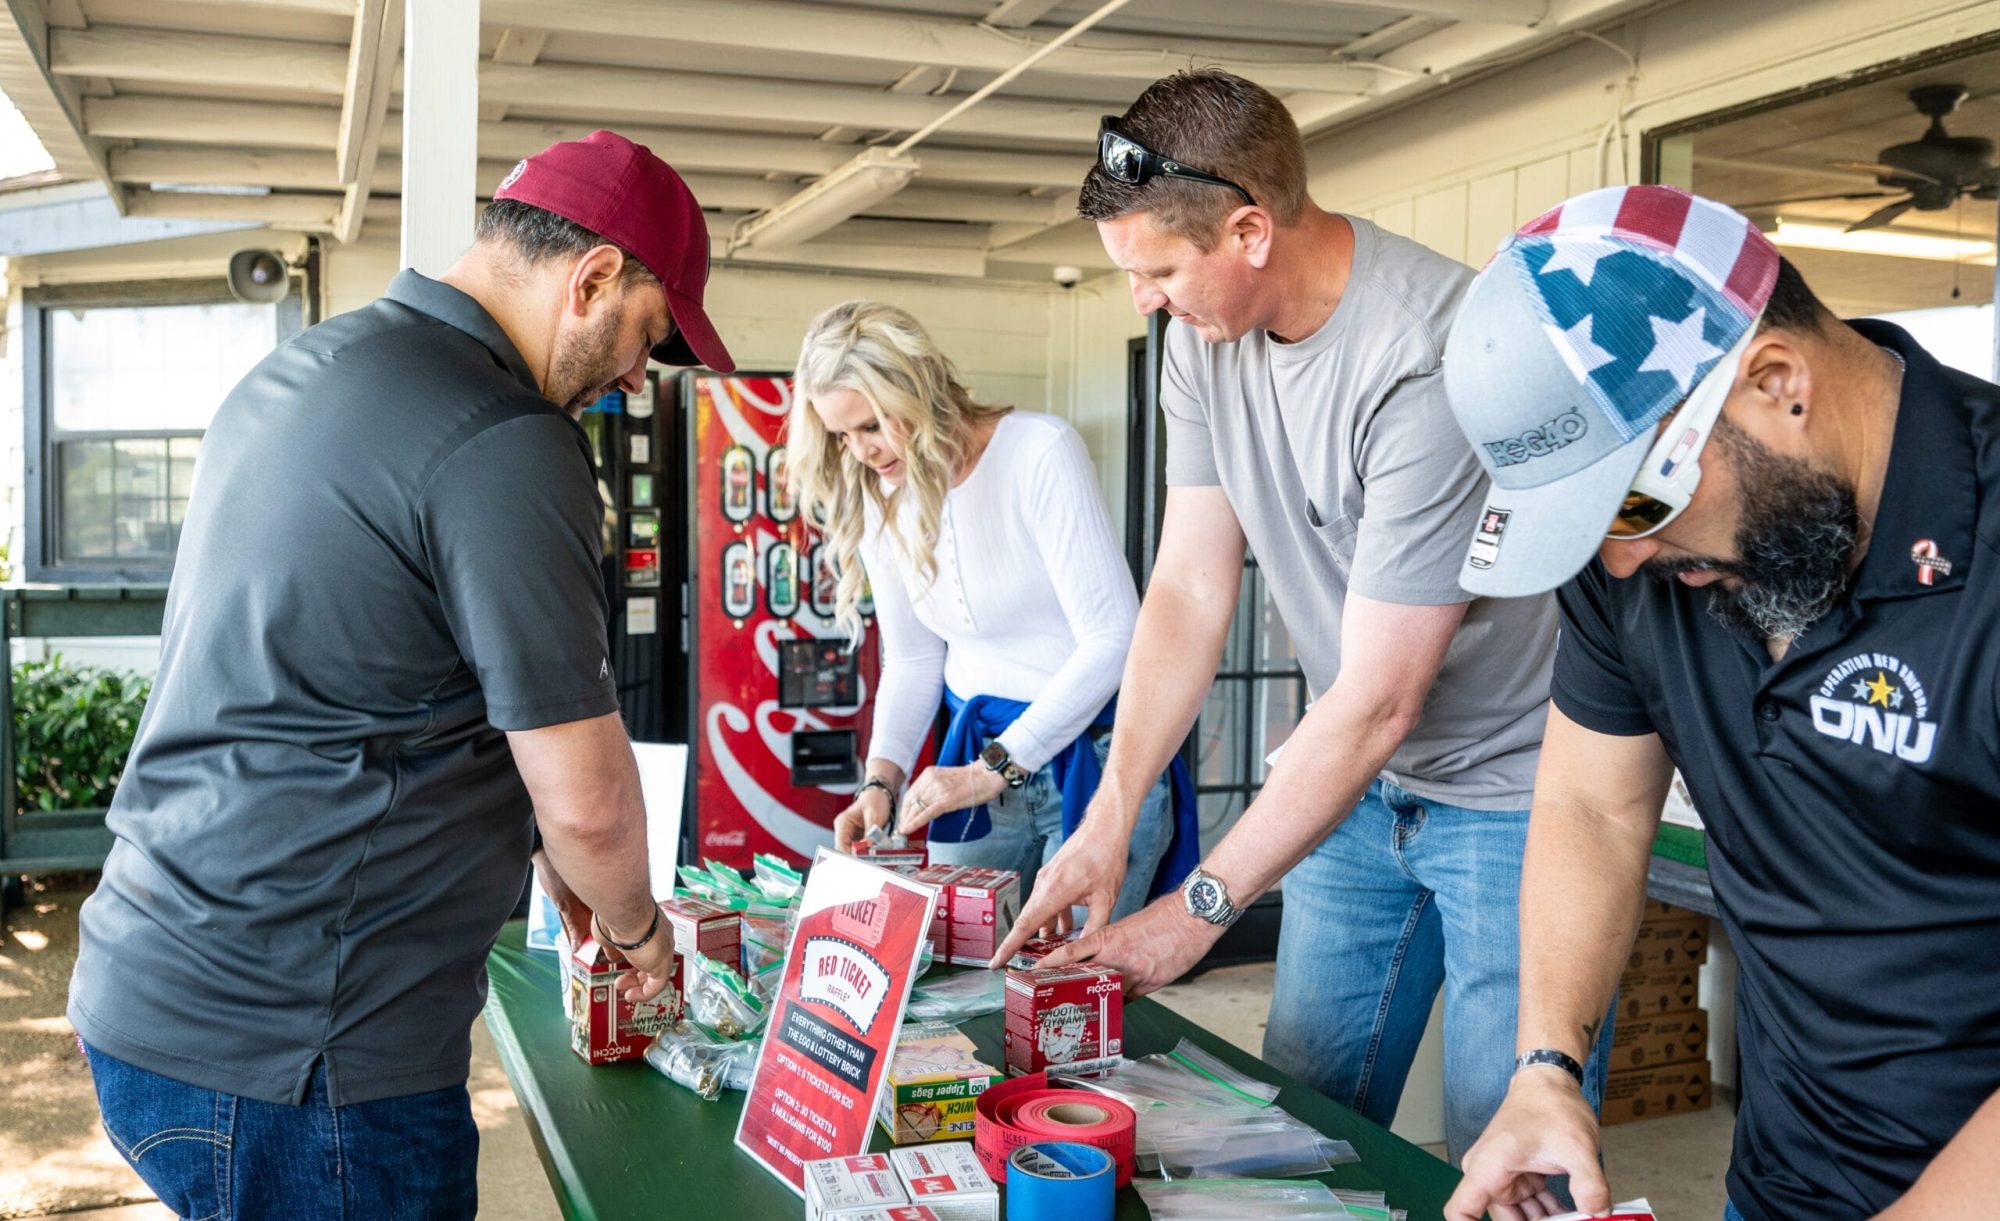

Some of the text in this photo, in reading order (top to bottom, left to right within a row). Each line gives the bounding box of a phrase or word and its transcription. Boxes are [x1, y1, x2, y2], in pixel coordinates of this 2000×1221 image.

[1820, 653, 1872, 697] OPERATION
[1872, 653, 1899, 673] NEW
[1810, 694, 1937, 763] ONU
[818, 955, 872, 1000] RED TICKET
[1086, 982, 1122, 995] FIOCCHI
[1037, 1005, 1092, 1019] SHOOTING
[593, 1045, 631, 1058] FIOCCHI
[787, 1027, 861, 1080] THE EGG & LOTTERY BRICK
[791, 1012, 866, 1063] EVERYTHING OTHER THAN
[776, 1053, 798, 1072] OPTION
[806, 1071, 829, 1094] TICKETS
[829, 1084, 841, 1102] FOR
[841, 1092, 854, 1110] $20
[912, 1083, 987, 1098] 100 Zipper Bags
[770, 1102, 832, 1153] 5 MULLIGANS FOR $100
[774, 1087, 794, 1108] OPTION
[800, 1104, 809, 1118] 30
[809, 1110, 832, 1134] TICKETS
[946, 1101, 976, 1115] WICH
[1003, 1131, 1027, 1145] TICKET
